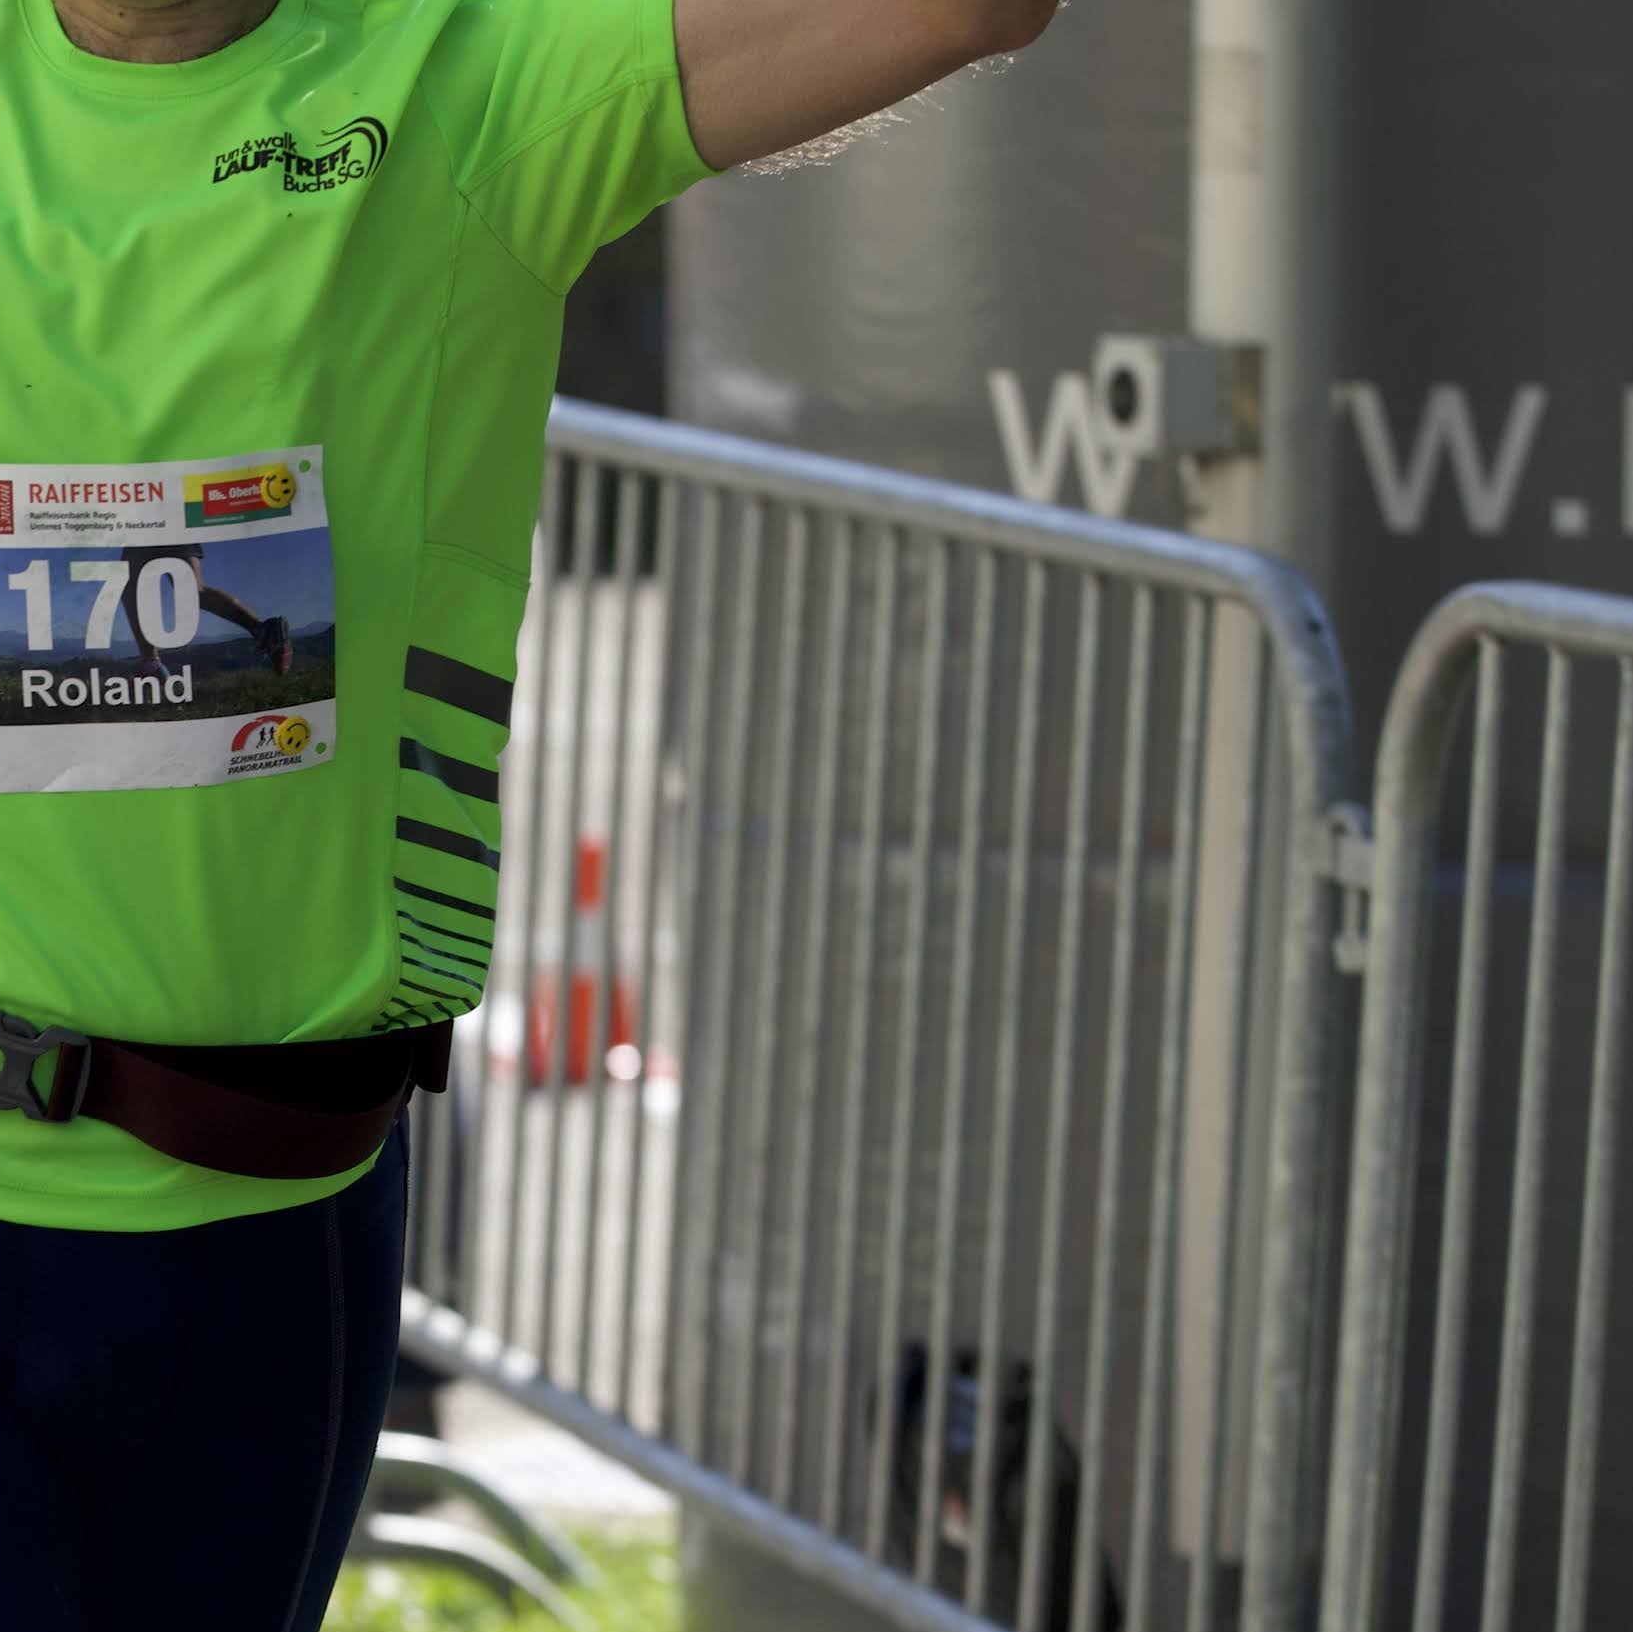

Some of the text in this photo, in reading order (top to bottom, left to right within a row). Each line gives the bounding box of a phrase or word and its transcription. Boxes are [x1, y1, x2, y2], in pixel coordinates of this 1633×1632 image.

[212, 140, 353, 184] LAUF-TREFF
[215, 131, 298, 166] run & walk
[283, 160, 364, 193] Buchs SG
[29, 482, 164, 503] RAIFFEISEN
[7, 556, 201, 651] 170
[20, 664, 194, 708] Roland
[228, 756, 302, 775] PANORAMATRAIL
[230, 751, 284, 765] SCHNEBELH
